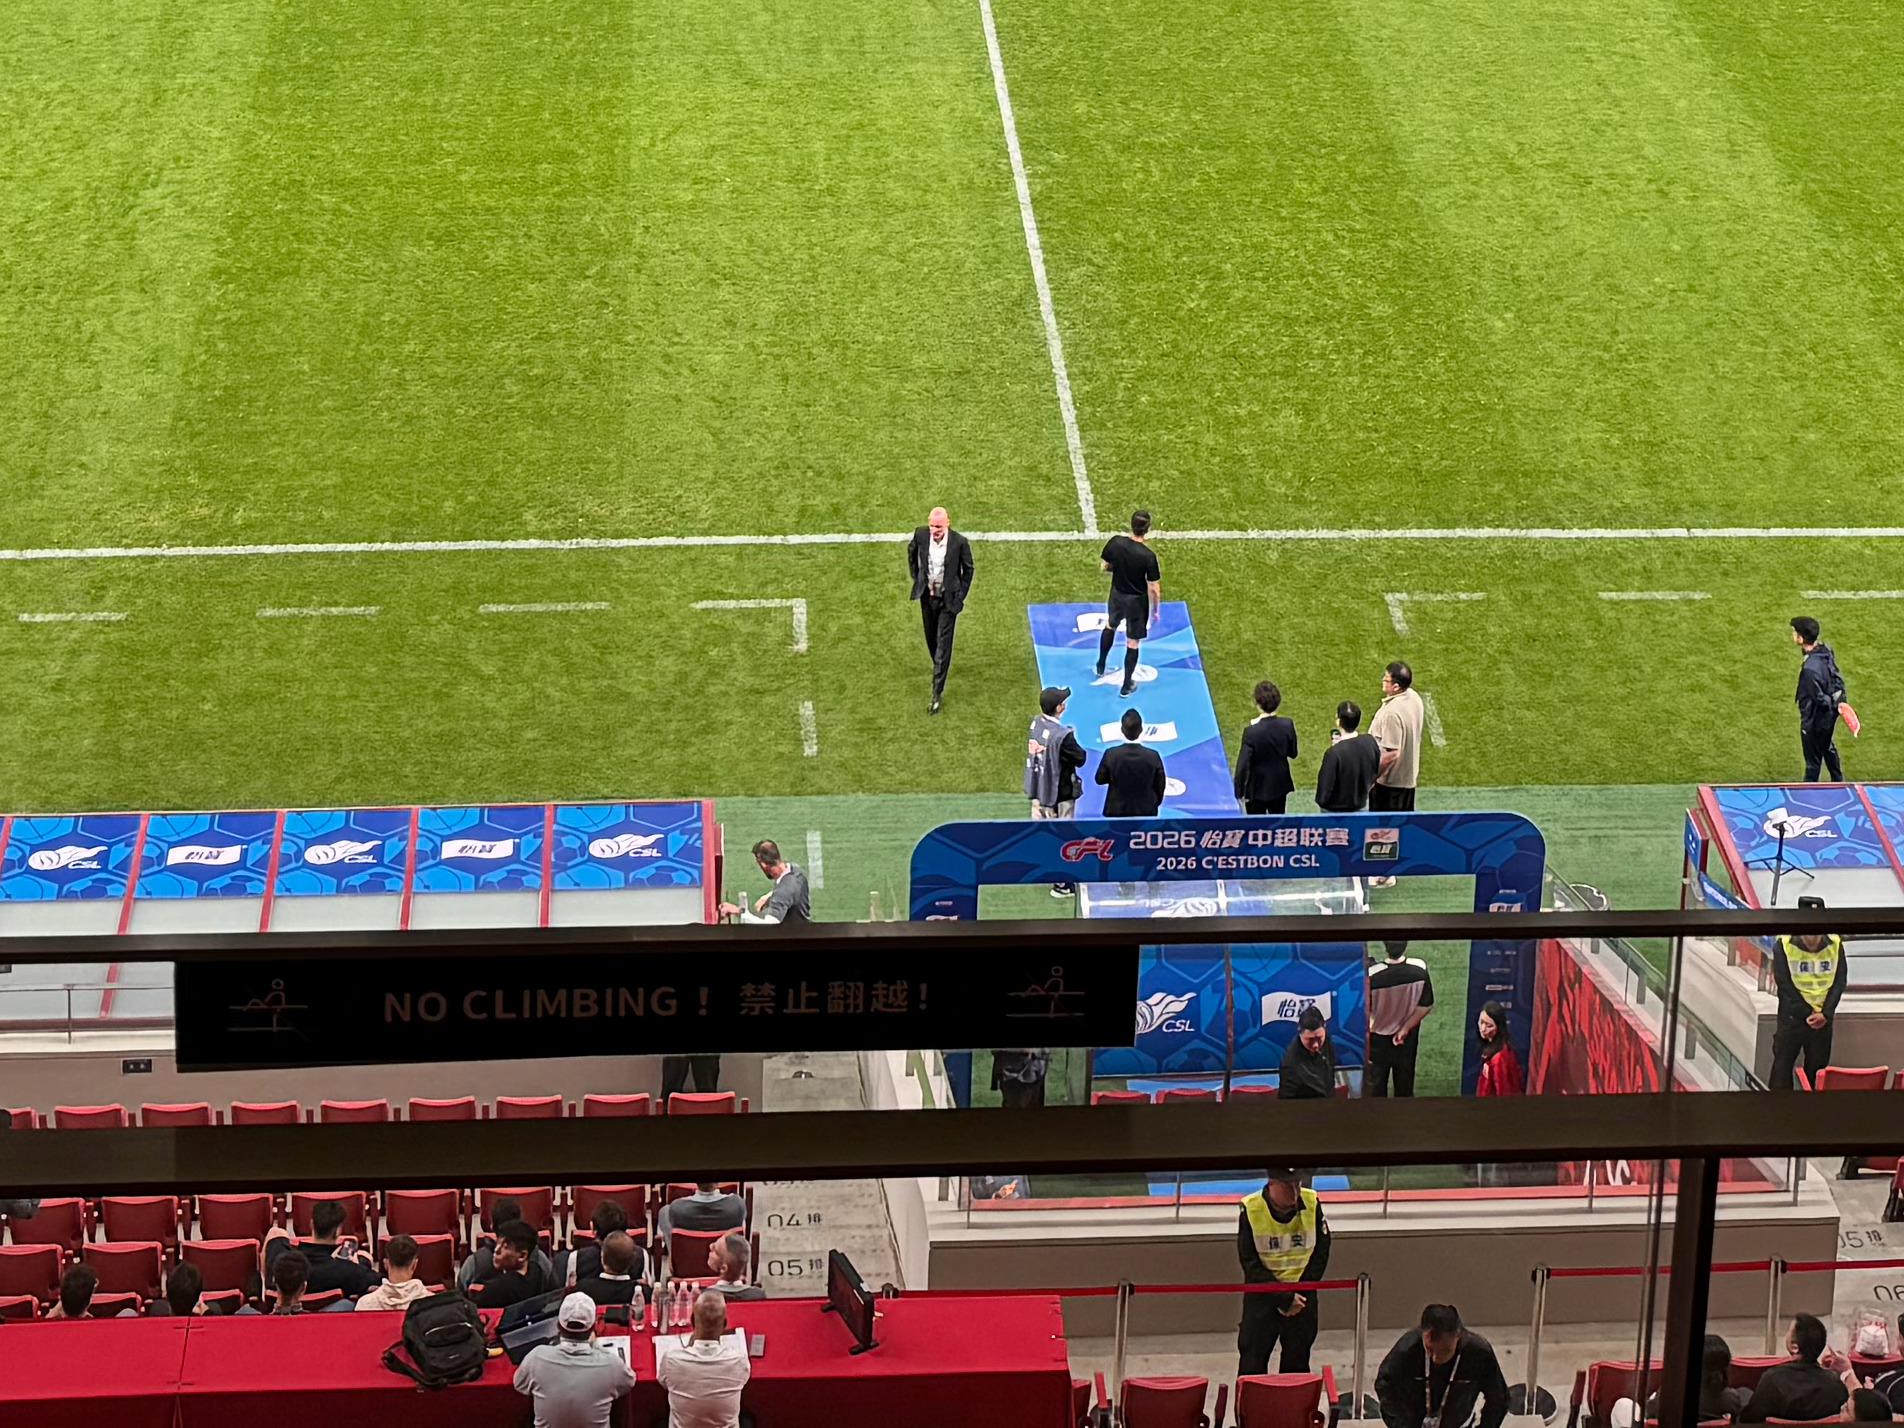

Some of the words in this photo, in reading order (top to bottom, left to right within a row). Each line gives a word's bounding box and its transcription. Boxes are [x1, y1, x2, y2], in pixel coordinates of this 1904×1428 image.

[1805, 830, 1838, 838] CSL
[628, 847, 661, 857] CSL
[344, 854, 377, 864] CSL
[1156, 856, 1197, 871] 2026
[1202, 855, 1285, 870] C'ESTBON
[1289, 854, 1320, 869] CSL
[68, 860, 102, 870] CSL
[384, 991, 448, 1023] NO
[1162, 1018, 1195, 1033] CSL
